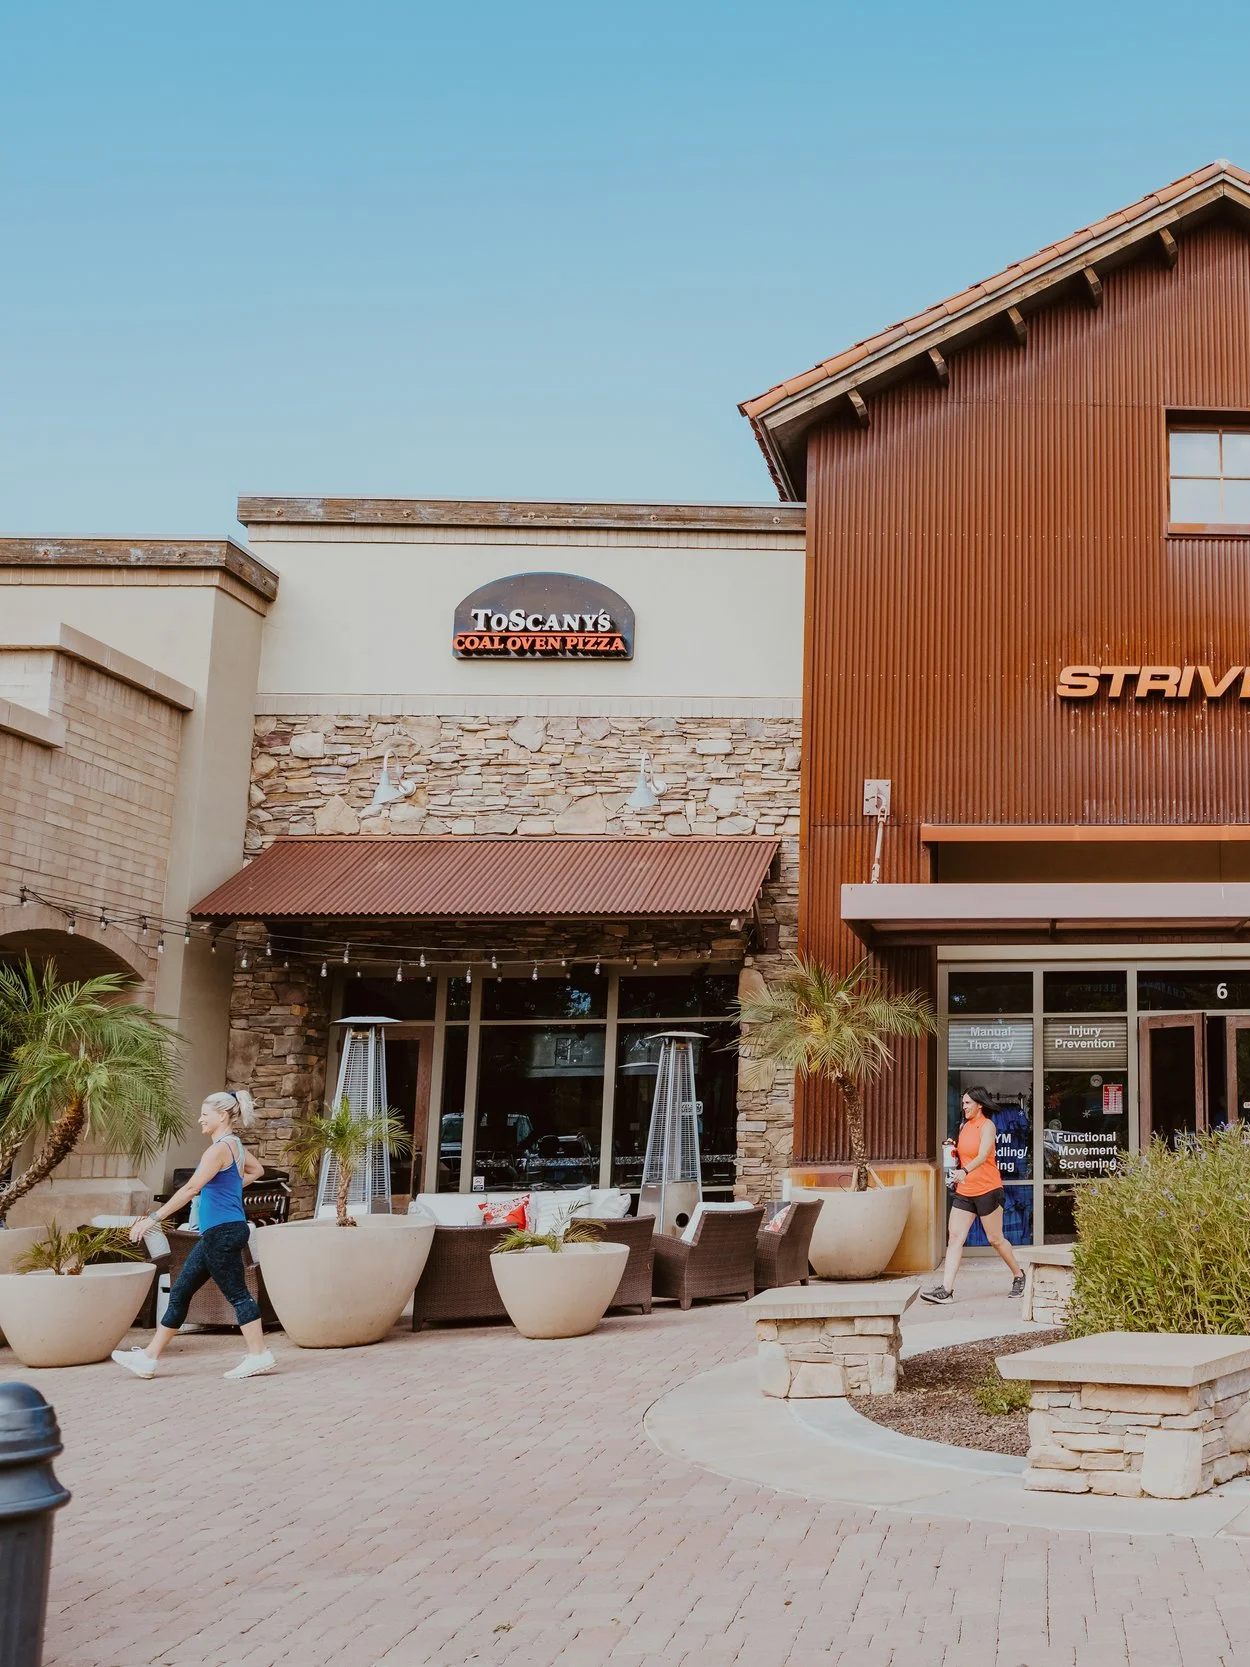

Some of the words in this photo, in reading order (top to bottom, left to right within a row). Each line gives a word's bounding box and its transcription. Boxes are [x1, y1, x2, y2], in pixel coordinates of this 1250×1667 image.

[453, 636, 504, 650] COAL
[507, 636, 562, 650] OVEN
[565, 636, 625, 651] PIZZA
[1216, 982, 1228, 999] 6
[970, 1026, 1011, 1037] Manual
[1069, 1025, 1101, 1038] Injury
[968, 1038, 1014, 1052] Therapy
[1055, 1038, 1116, 1049] Prevention
[995, 1133, 1012, 1143] YM
[1056, 1131, 1116, 1143] Functional
[994, 1146, 1028, 1159] dling/
[1058, 1145, 1117, 1156] Movement
[997, 1160, 1015, 1173] ing
[1059, 1158, 1117, 1171] Screening
